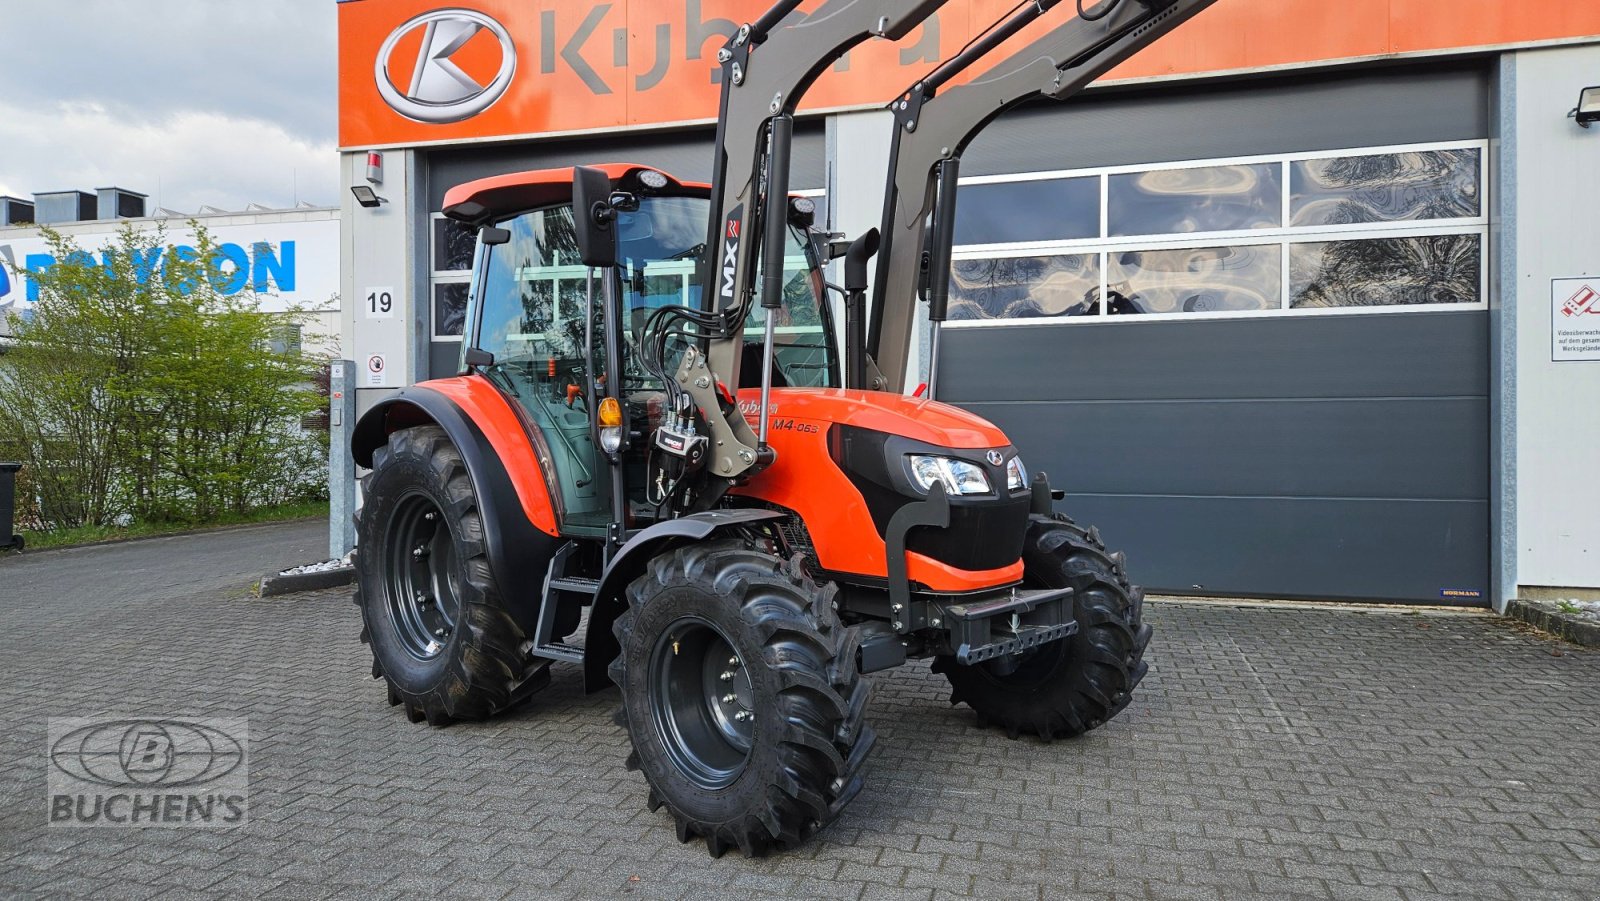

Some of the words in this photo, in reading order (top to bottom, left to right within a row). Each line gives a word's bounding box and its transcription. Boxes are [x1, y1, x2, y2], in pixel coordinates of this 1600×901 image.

[540, 0, 940, 96] Kuba
[721, 240, 738, 298] MX
[367, 292, 392, 313] 19
